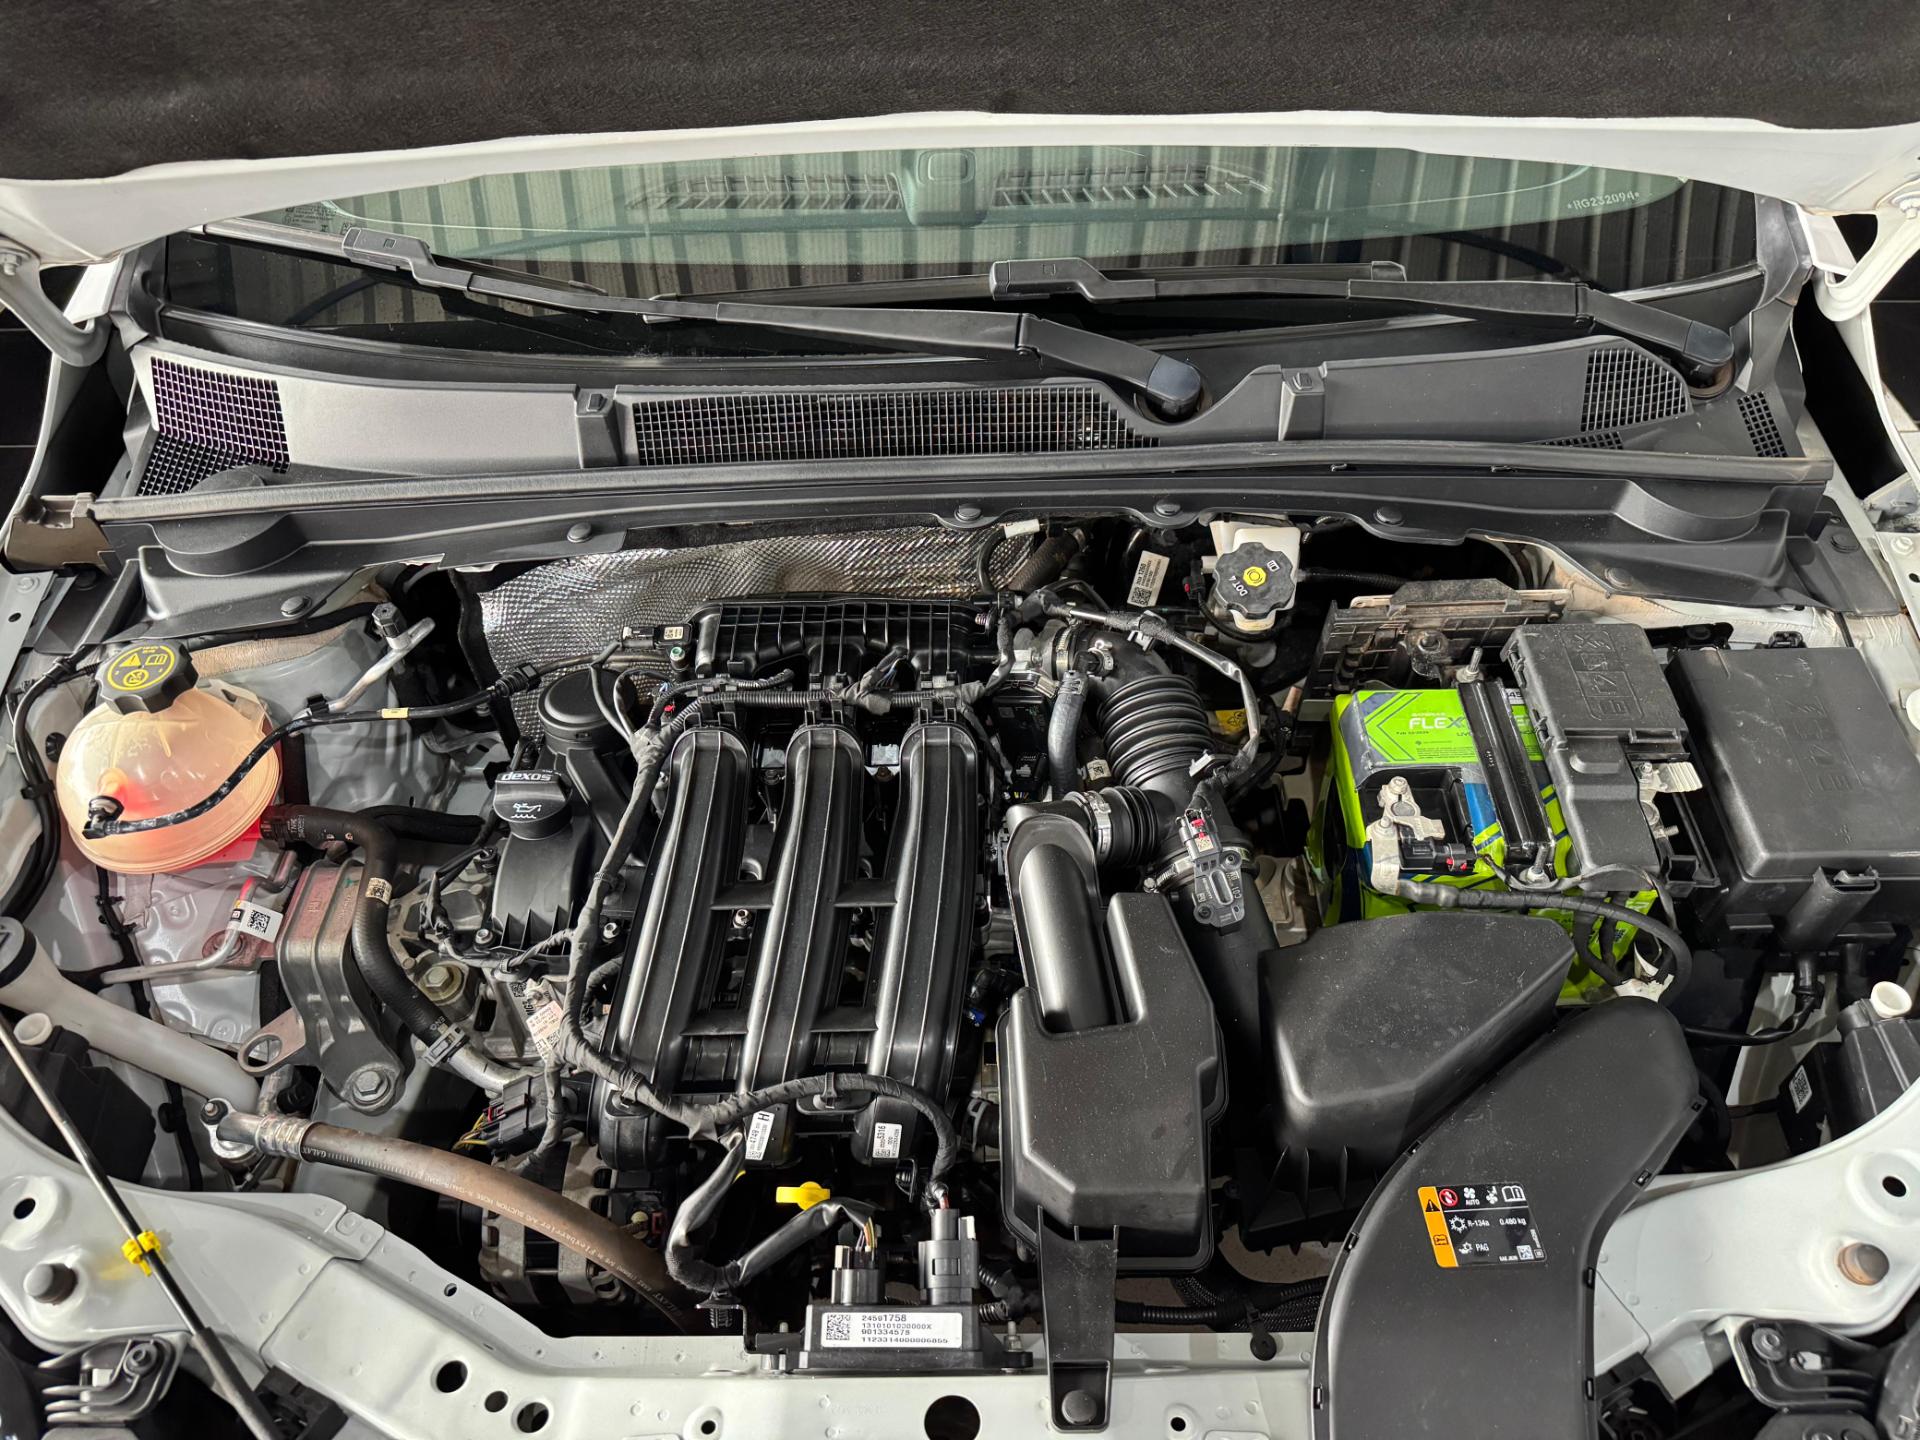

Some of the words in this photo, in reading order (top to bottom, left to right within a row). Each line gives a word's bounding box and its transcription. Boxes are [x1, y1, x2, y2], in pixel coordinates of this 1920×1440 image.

[1231, 581, 1248, 596] DOT
[1409, 717, 1464, 729] FLEX
[500, 771, 552, 781] dexos
[1475, 1243, 1489, 1251] PAG
